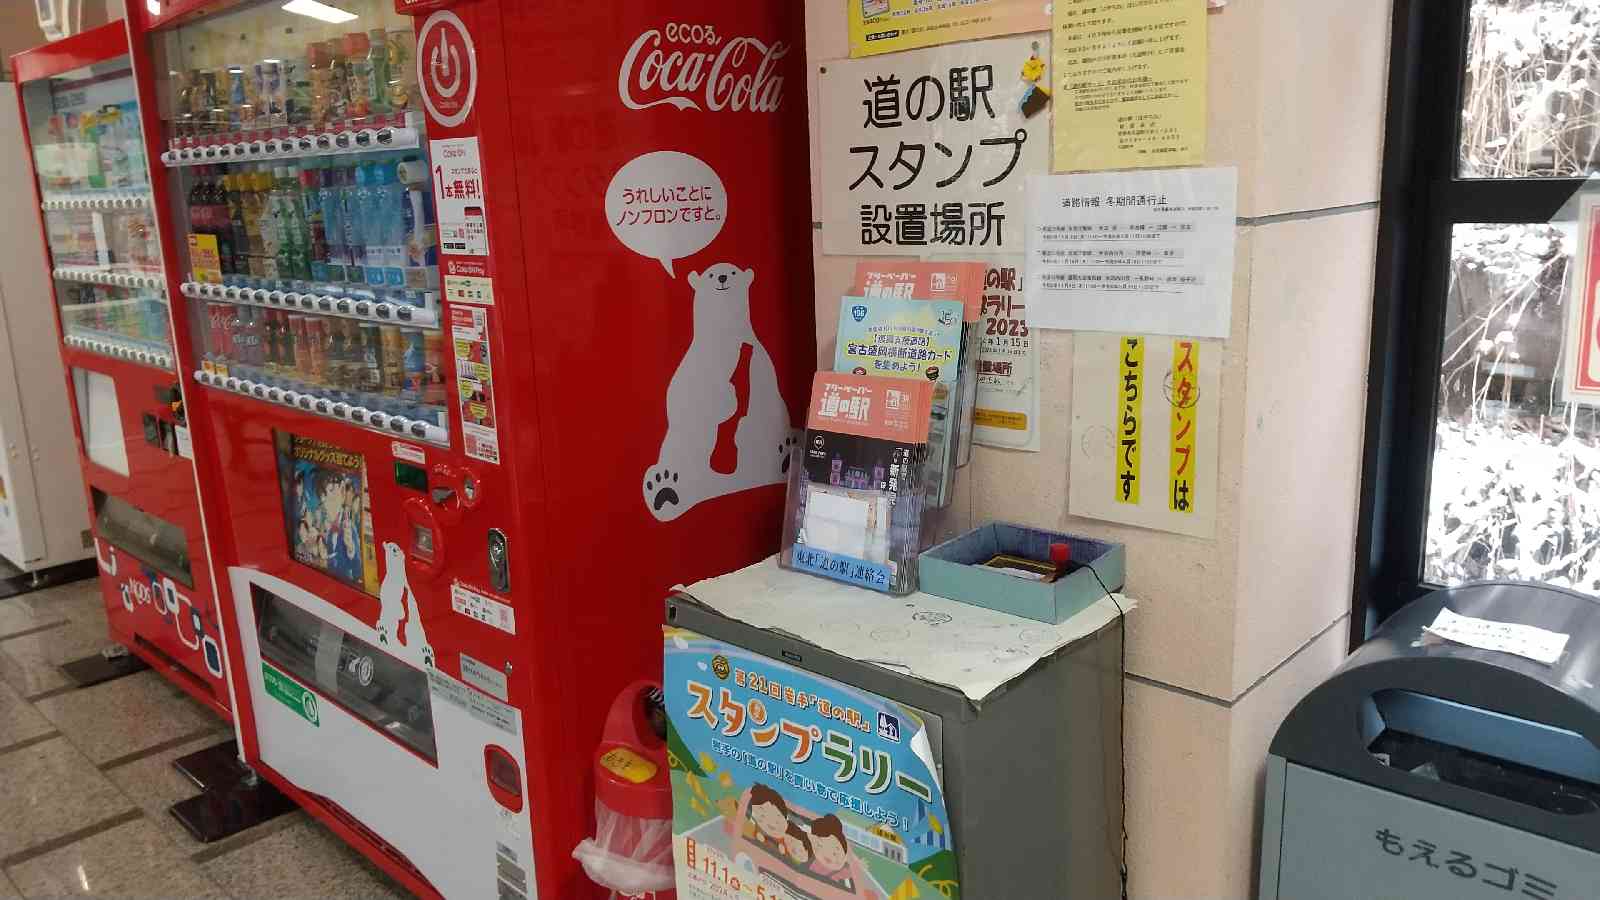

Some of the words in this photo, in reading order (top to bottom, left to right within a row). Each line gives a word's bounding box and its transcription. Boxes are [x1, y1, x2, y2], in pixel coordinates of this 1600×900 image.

[618, 30, 790, 112] Coca-Cola
[863, 64, 995, 128] 道の駅
[849, 128, 1027, 190] スタンプ
[616, 204, 721, 226] ノンフロンですと。
[622, 185, 712, 205] うれしいことに
[860, 201, 1006, 246] 設置場所
[817, 391, 872, 421] 道の駅
[1120, 337, 1139, 502] こちらです
[1173, 341, 1194, 512] スタンプは
[687, 679, 933, 803] スタンプラリー
[1375, 828, 1559, 900] もえるゴミ
